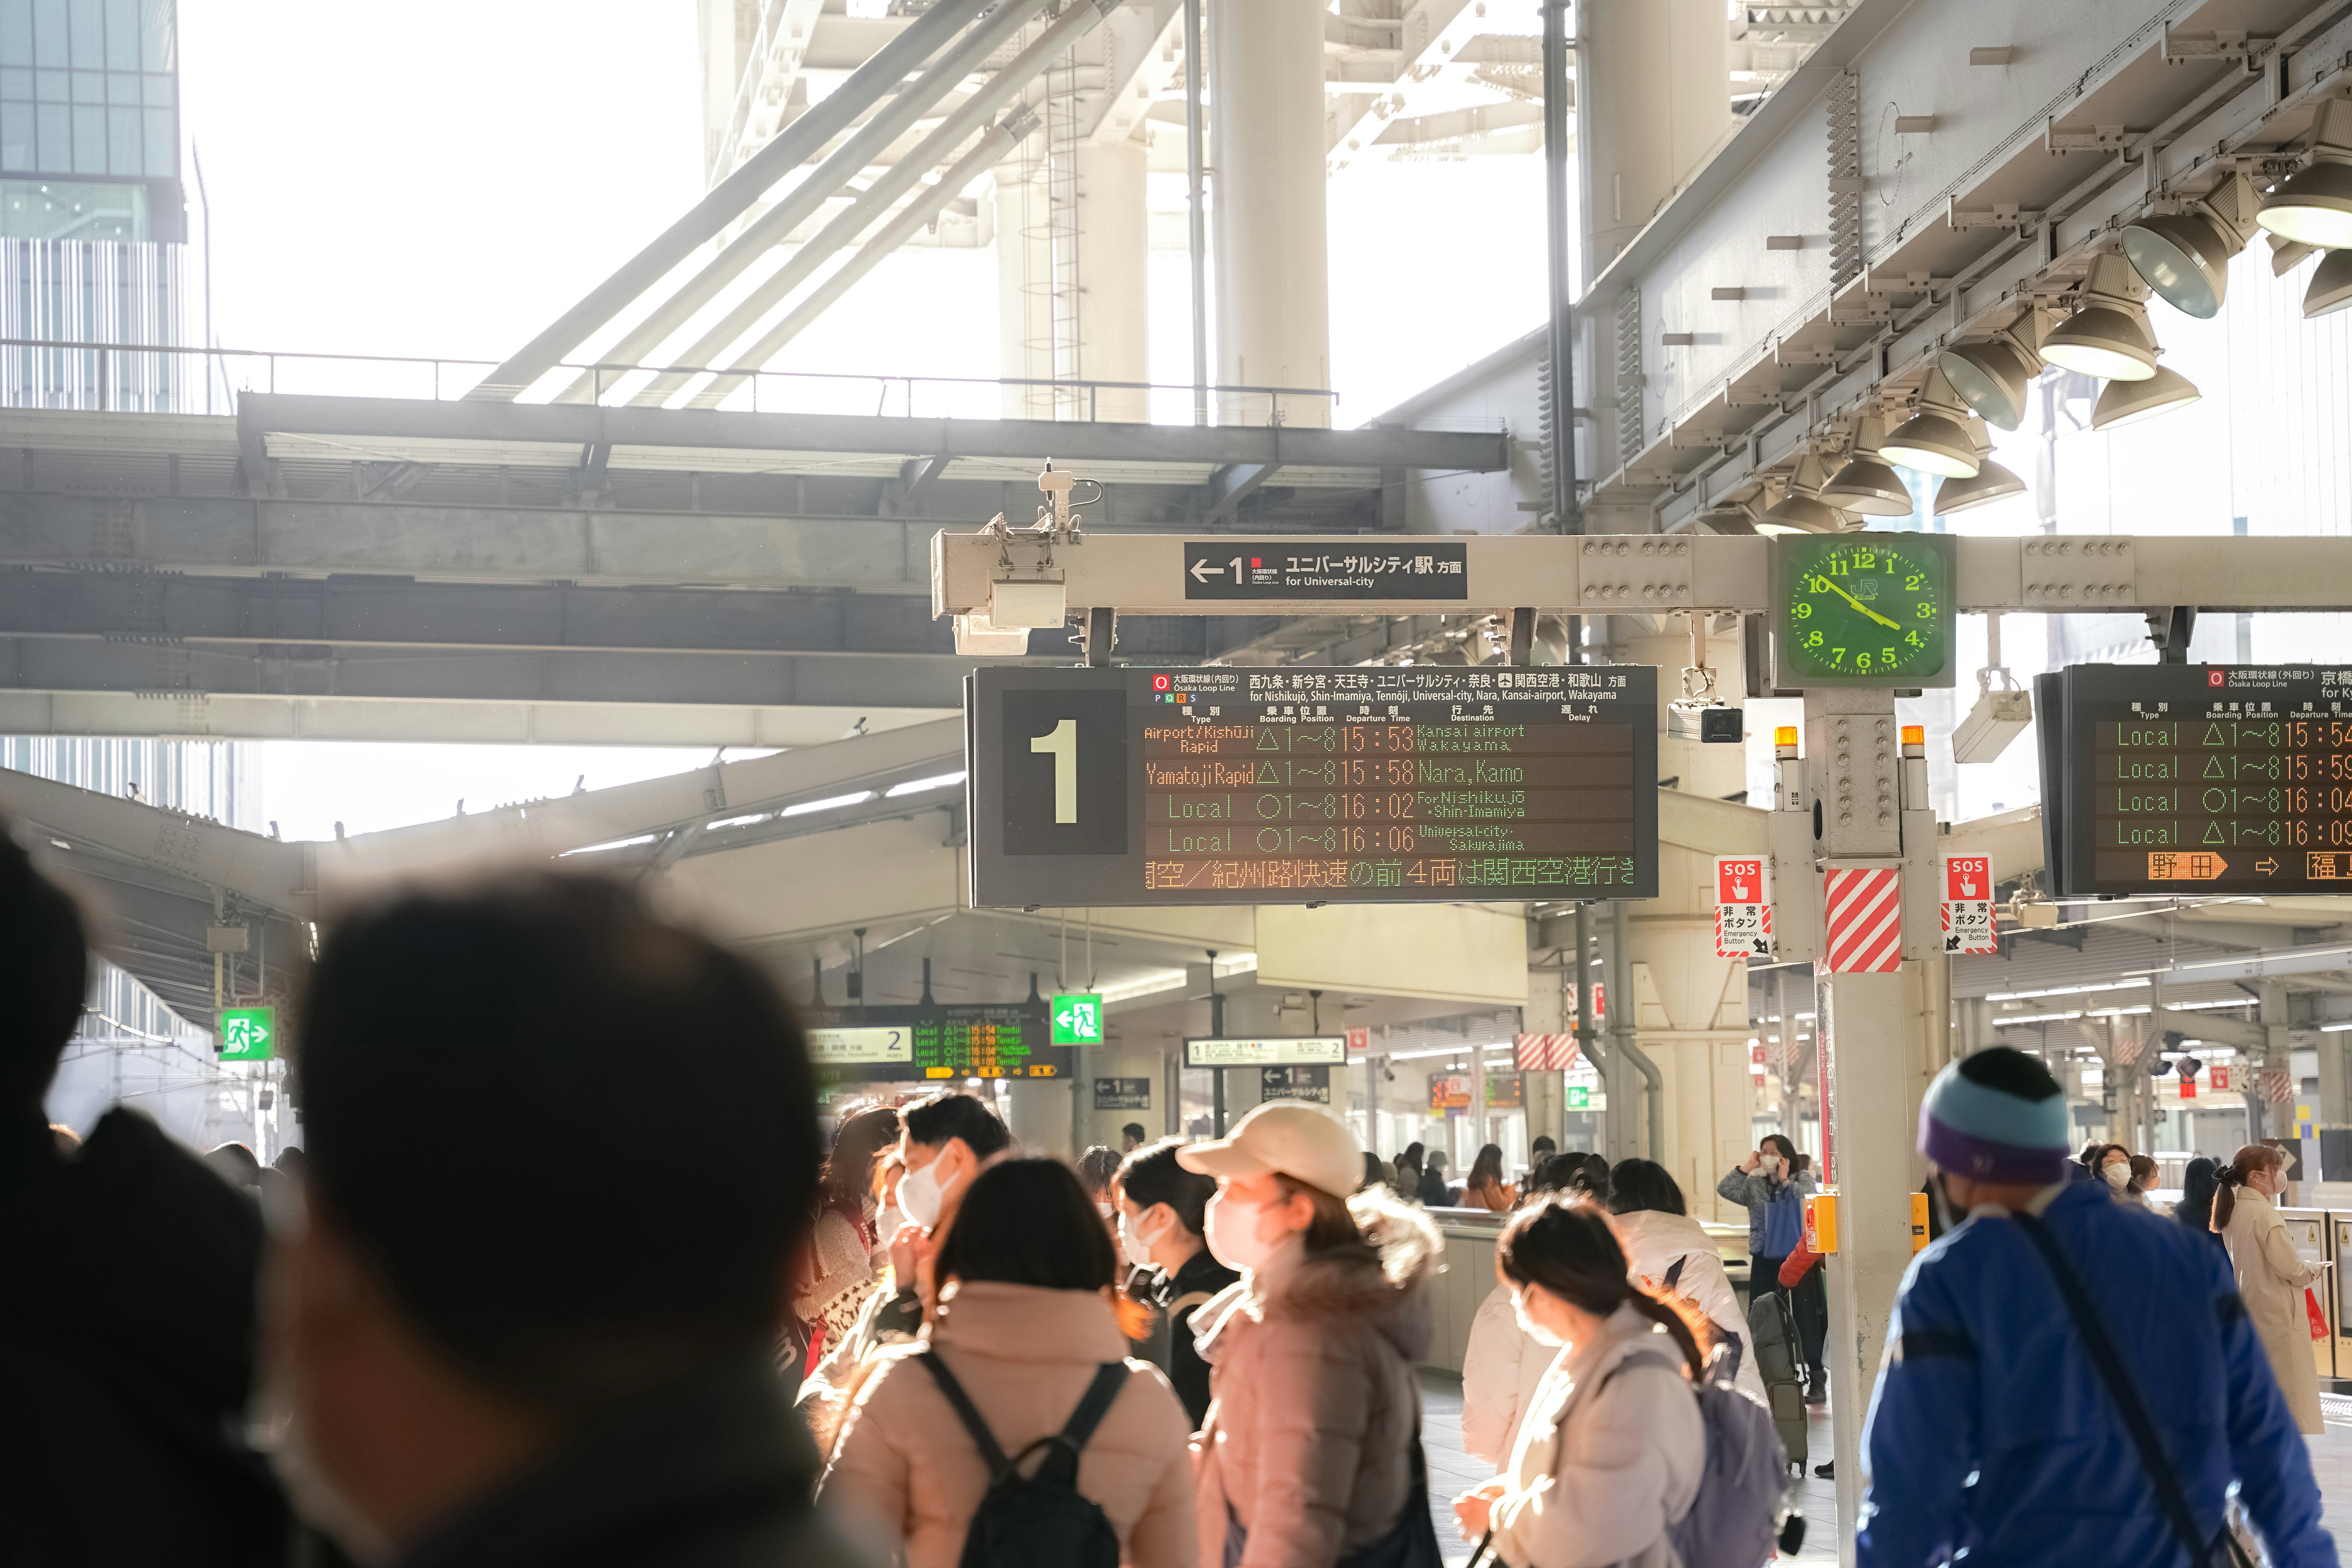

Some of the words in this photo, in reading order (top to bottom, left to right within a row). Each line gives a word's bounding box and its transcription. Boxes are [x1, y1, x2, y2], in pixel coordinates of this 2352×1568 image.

[1286, 555, 1434, 574] ユニバーサルシティ駅
[1437, 561, 1462, 574] 方面
[1829, 560, 1849, 575] 11
[1852, 553, 1875, 568] 12
[1886, 559, 1895, 573] 1
[1229, 557, 1242, 584] 1
[1285, 576, 1301, 586] for
[1304, 576, 1374, 588] Universal-city
[1808, 578, 1831, 593] 10
[1851, 579, 1878, 595] JR
[1905, 575, 1919, 590] 2
[1797, 603, 1812, 619] 9
[1916, 603, 1931, 618] 3
[1808, 631, 1824, 646] 8
[1905, 630, 1920, 645] 4
[1832, 648, 1846, 663] 7
[1857, 653, 1871, 668] 6
[1882, 647, 1896, 663] 5
[1199, 684, 1218, 693] Loop
[1608, 675, 1626, 688] 方面
[1250, 691, 1263, 701] for
[1265, 691, 1308, 704] Nishikujō,
[1311, 690, 1374, 704] Shin-Imamiya,
[1376, 690, 1410, 703] Tennōji,
[1413, 690, 1474, 703] Universal-city,
[1476, 690, 1500, 702] Nara,
[1502, 690, 1566, 702] Kansai-airport,
[1568, 690, 1617, 702] Wakayama
[2321, 687, 2339, 698] for
[1191, 716, 1211, 724] Type
[1259, 715, 1297, 724] Boarding
[1346, 715, 1386, 723] Departure
[1568, 714, 1591, 722] Delay
[2140, 711, 2160, 720] Type
[1417, 724, 1467, 737] Kansai
[2118, 722, 2177, 746] Local
[1341, 726, 1413, 751] 15:53
[1417, 739, 1509, 752] Wakayama
[1180, 739, 1218, 754] Rapid
[1031, 719, 1077, 824] 1
[1341, 760, 1413, 785] 15:58
[2118, 755, 2177, 779] Local
[1169, 794, 1230, 818] Local
[1341, 793, 1413, 818] 16:02
[2118, 788, 2177, 811] Local
[1169, 828, 1230, 851] Local
[1341, 827, 1414, 852] 16:06
[2118, 821, 2177, 844] Local
[1450, 838, 1524, 852] Sakurajima
[1724, 864, 1756, 876] SOS
[1953, 860, 1983, 873] SOS
[2153, 854, 2211, 878] 野田
[1724, 906, 1756, 916] 非常
[1955, 902, 1987, 913] 非常
[1724, 918, 1757, 928] ボタン
[1956, 915, 1987, 925] ボタン
[887, 1031, 901, 1050] 2
